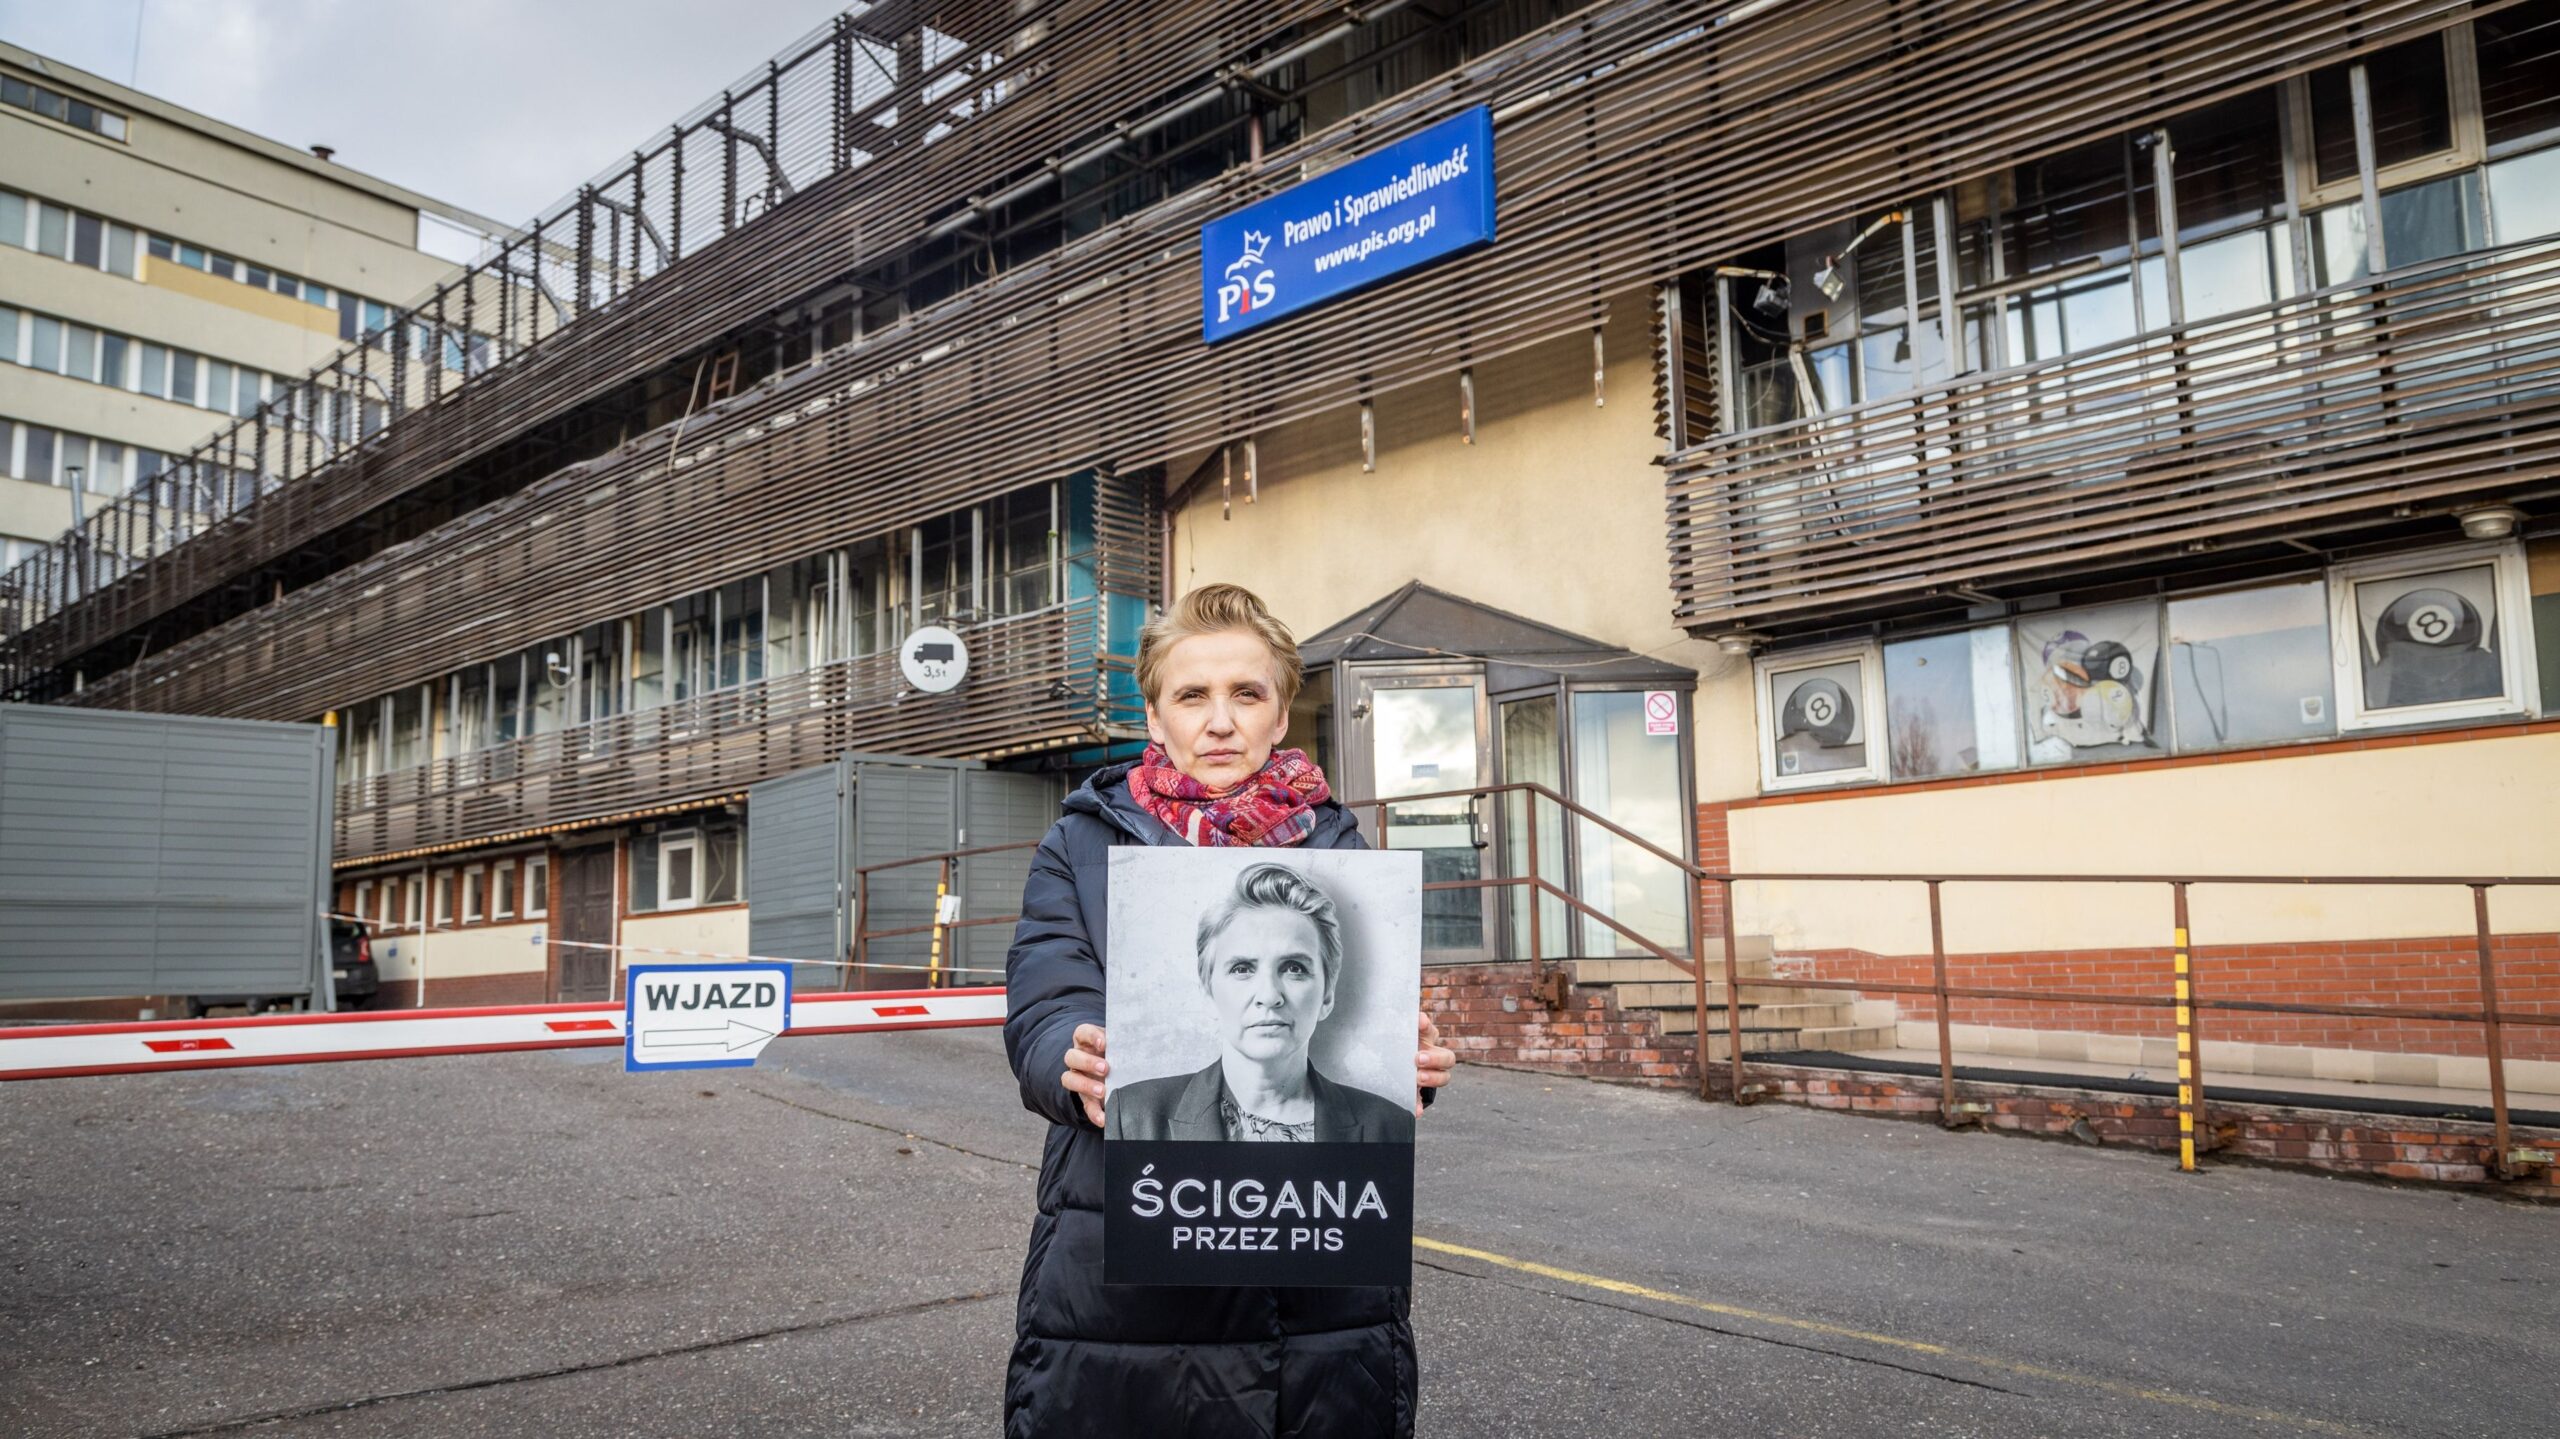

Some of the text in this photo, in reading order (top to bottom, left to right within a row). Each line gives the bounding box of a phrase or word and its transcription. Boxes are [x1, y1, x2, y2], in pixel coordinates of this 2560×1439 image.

[1284, 144, 1469, 246] Prawo i Sprawiedliwość
[1315, 205, 1436, 272] www.pis.org.pl
[2416, 611, 2447, 638] 8
[1811, 697, 1831, 720] 8
[645, 982, 777, 1011] WJAZD
[1131, 1163, 1388, 1219] ŚCIGANA
[1173, 1227, 1344, 1251] PRZEZ PIS
